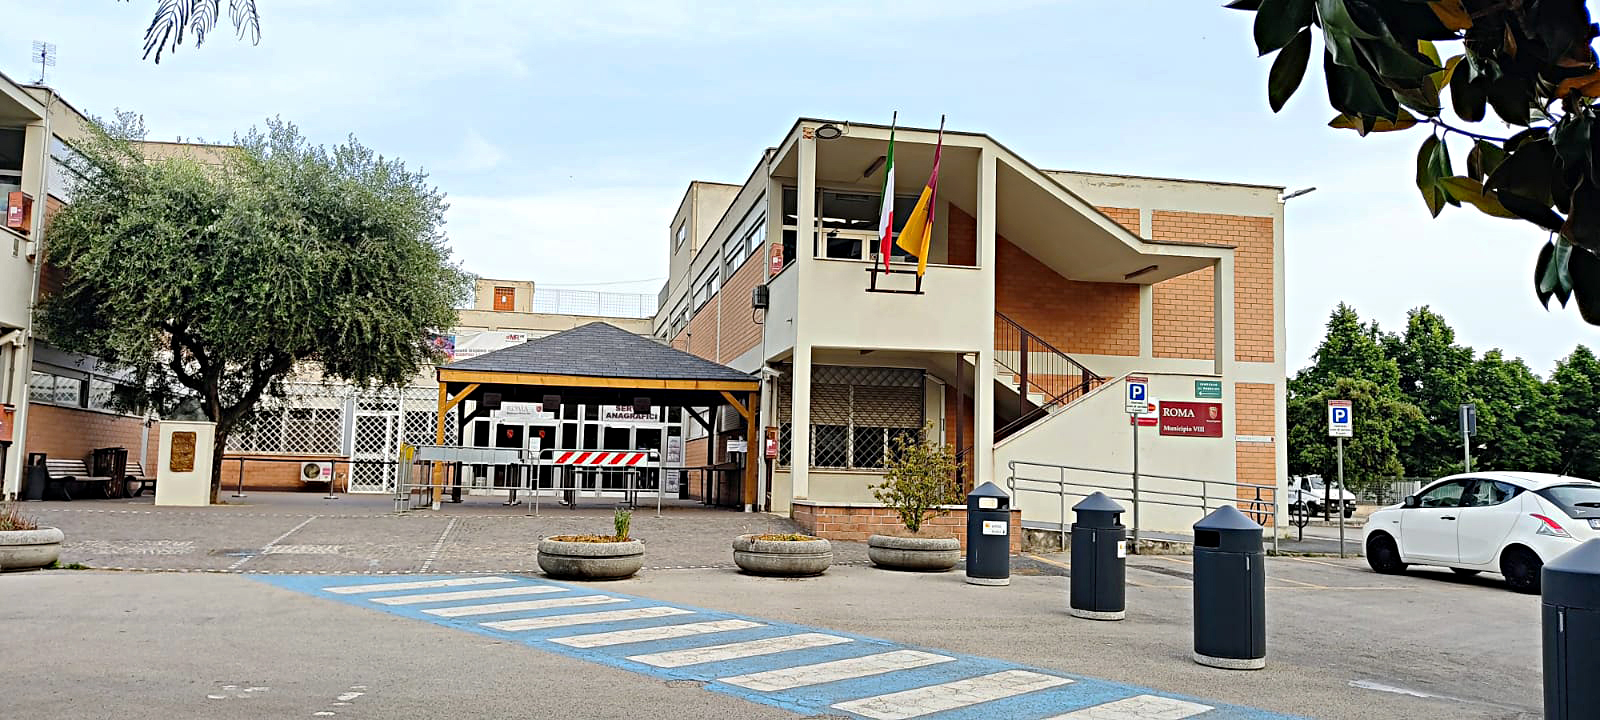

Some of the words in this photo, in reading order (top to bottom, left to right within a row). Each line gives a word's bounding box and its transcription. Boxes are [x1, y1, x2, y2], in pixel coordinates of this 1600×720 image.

[1132, 385, 1142, 399] P
[1162, 407, 1195, 418] ROMA
[1335, 409, 1345, 422] P
[1163, 425, 1192, 433] Municipio
